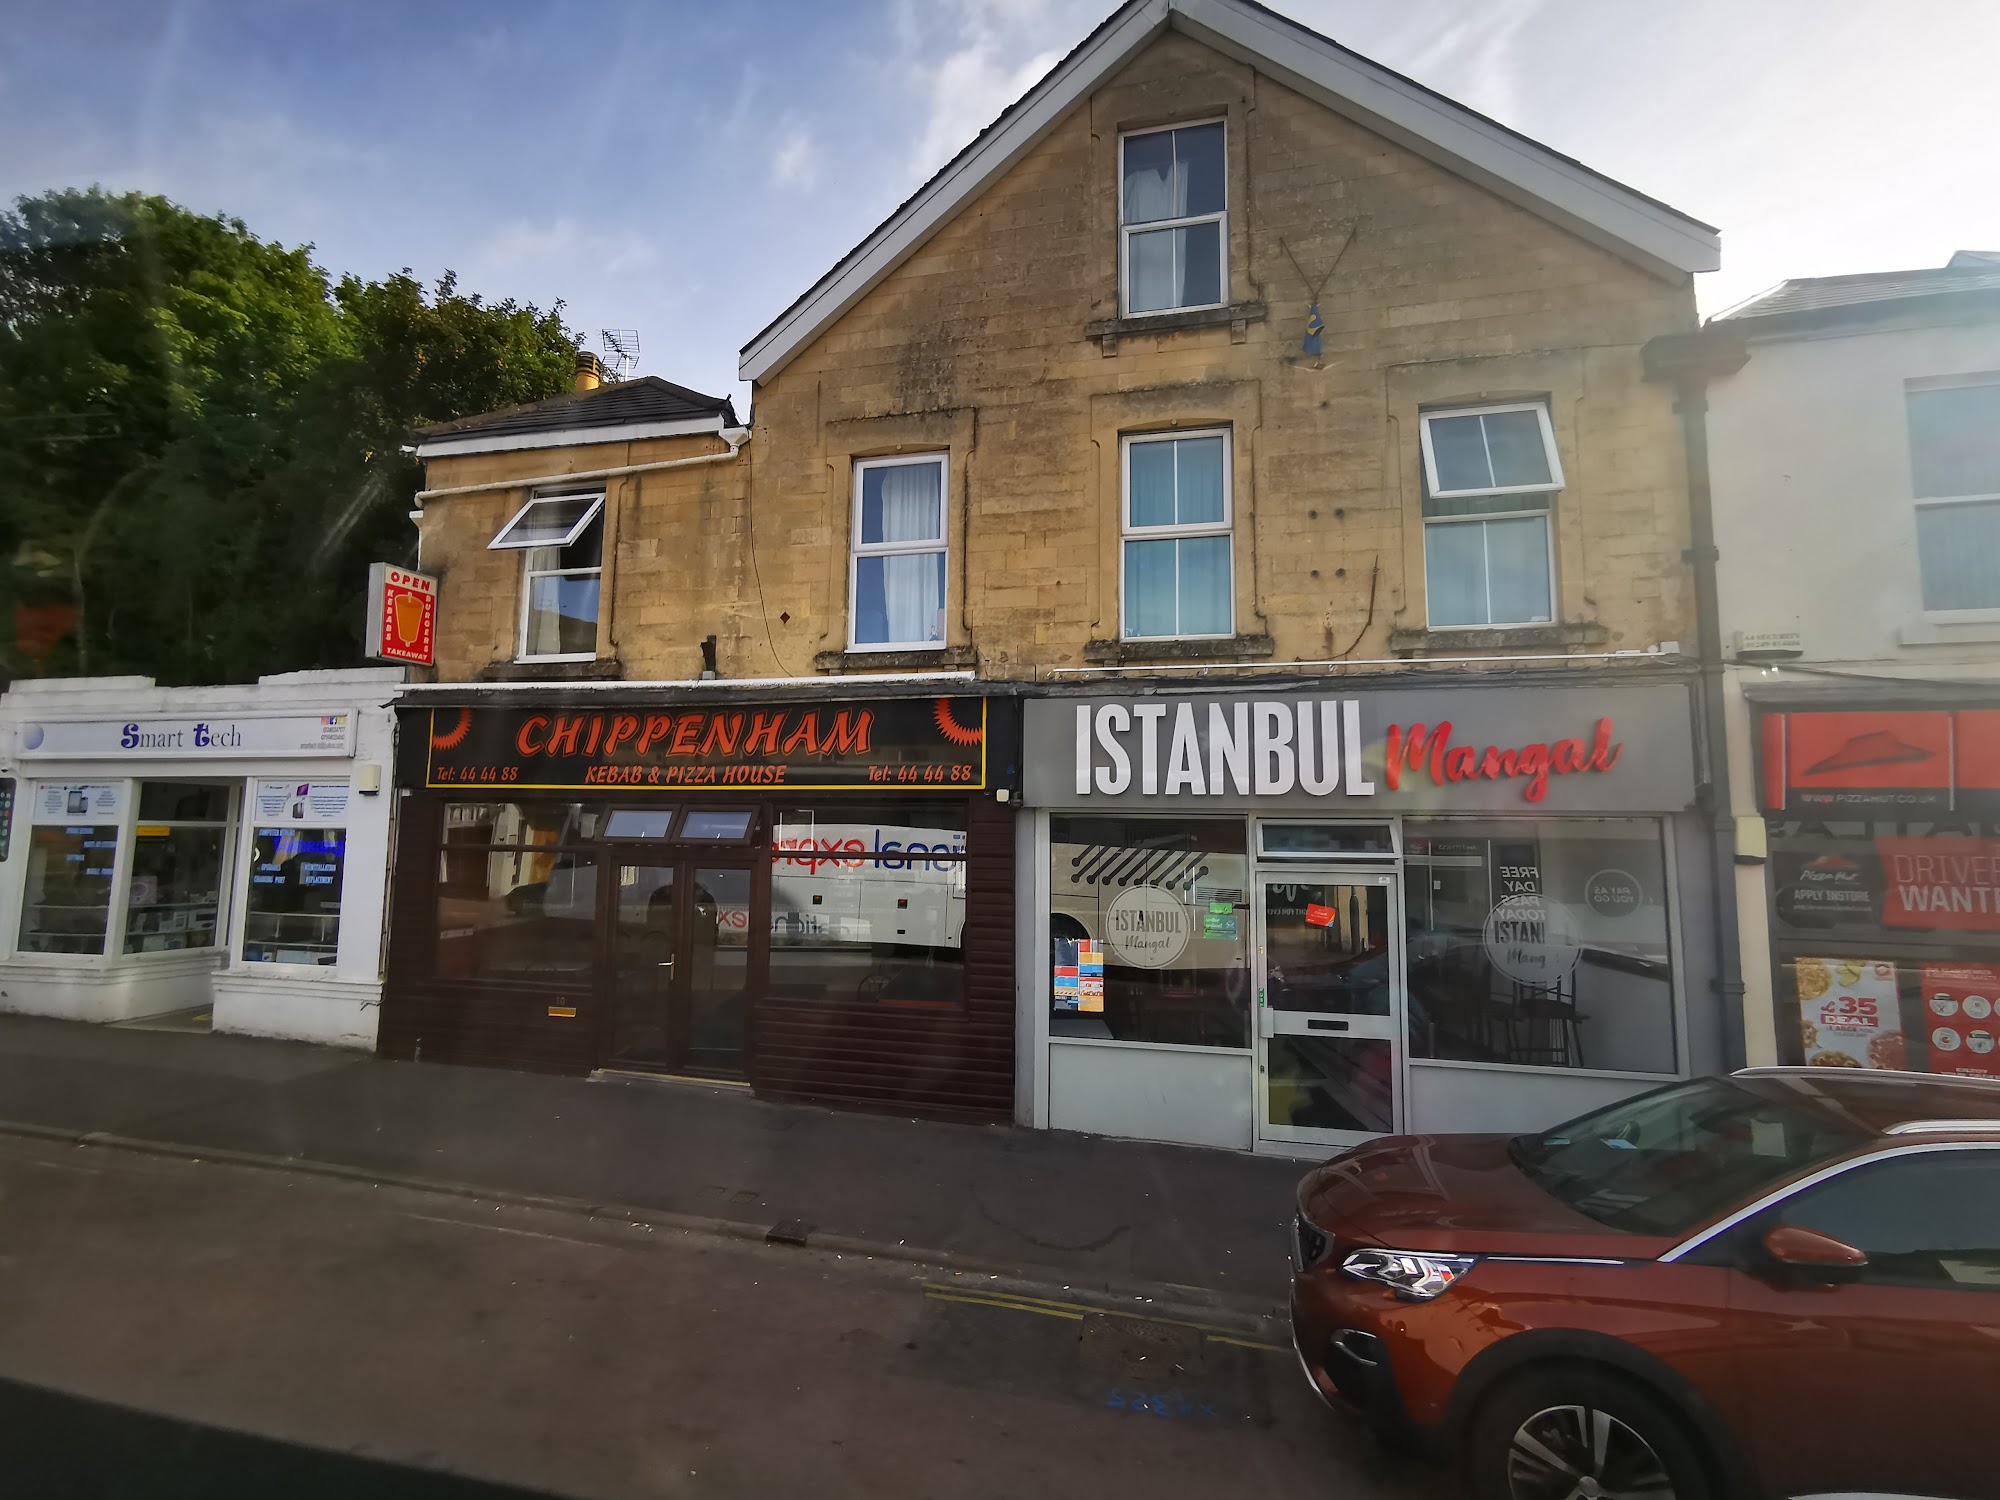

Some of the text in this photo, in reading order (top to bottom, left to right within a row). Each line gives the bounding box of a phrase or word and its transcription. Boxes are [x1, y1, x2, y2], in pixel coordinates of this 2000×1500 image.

[390, 571, 431, 592] OPEN
[385, 589, 395, 641] KEBABS
[423, 595, 432, 653] BURGERS
[386, 647, 428, 661] TAKEAWAY
[120, 722, 242, 749] Smart tech
[516, 707, 876, 758] CHIPPENHAM
[1075, 700, 1623, 803] ISTANBUL Mangal
[437, 766, 519, 782] Tel: 44 44 88
[584, 765, 788, 784] KEBAB & PIZZA HOUSE
[868, 765, 973, 783] Tel: 44 44 88
[1793, 889, 1870, 902] APPLY INSTORE
[1115, 909, 1182, 934] ISTANBUL
[1125, 935, 1171, 953] Mangal
[1825, 1015, 1875, 1026] DEAL
